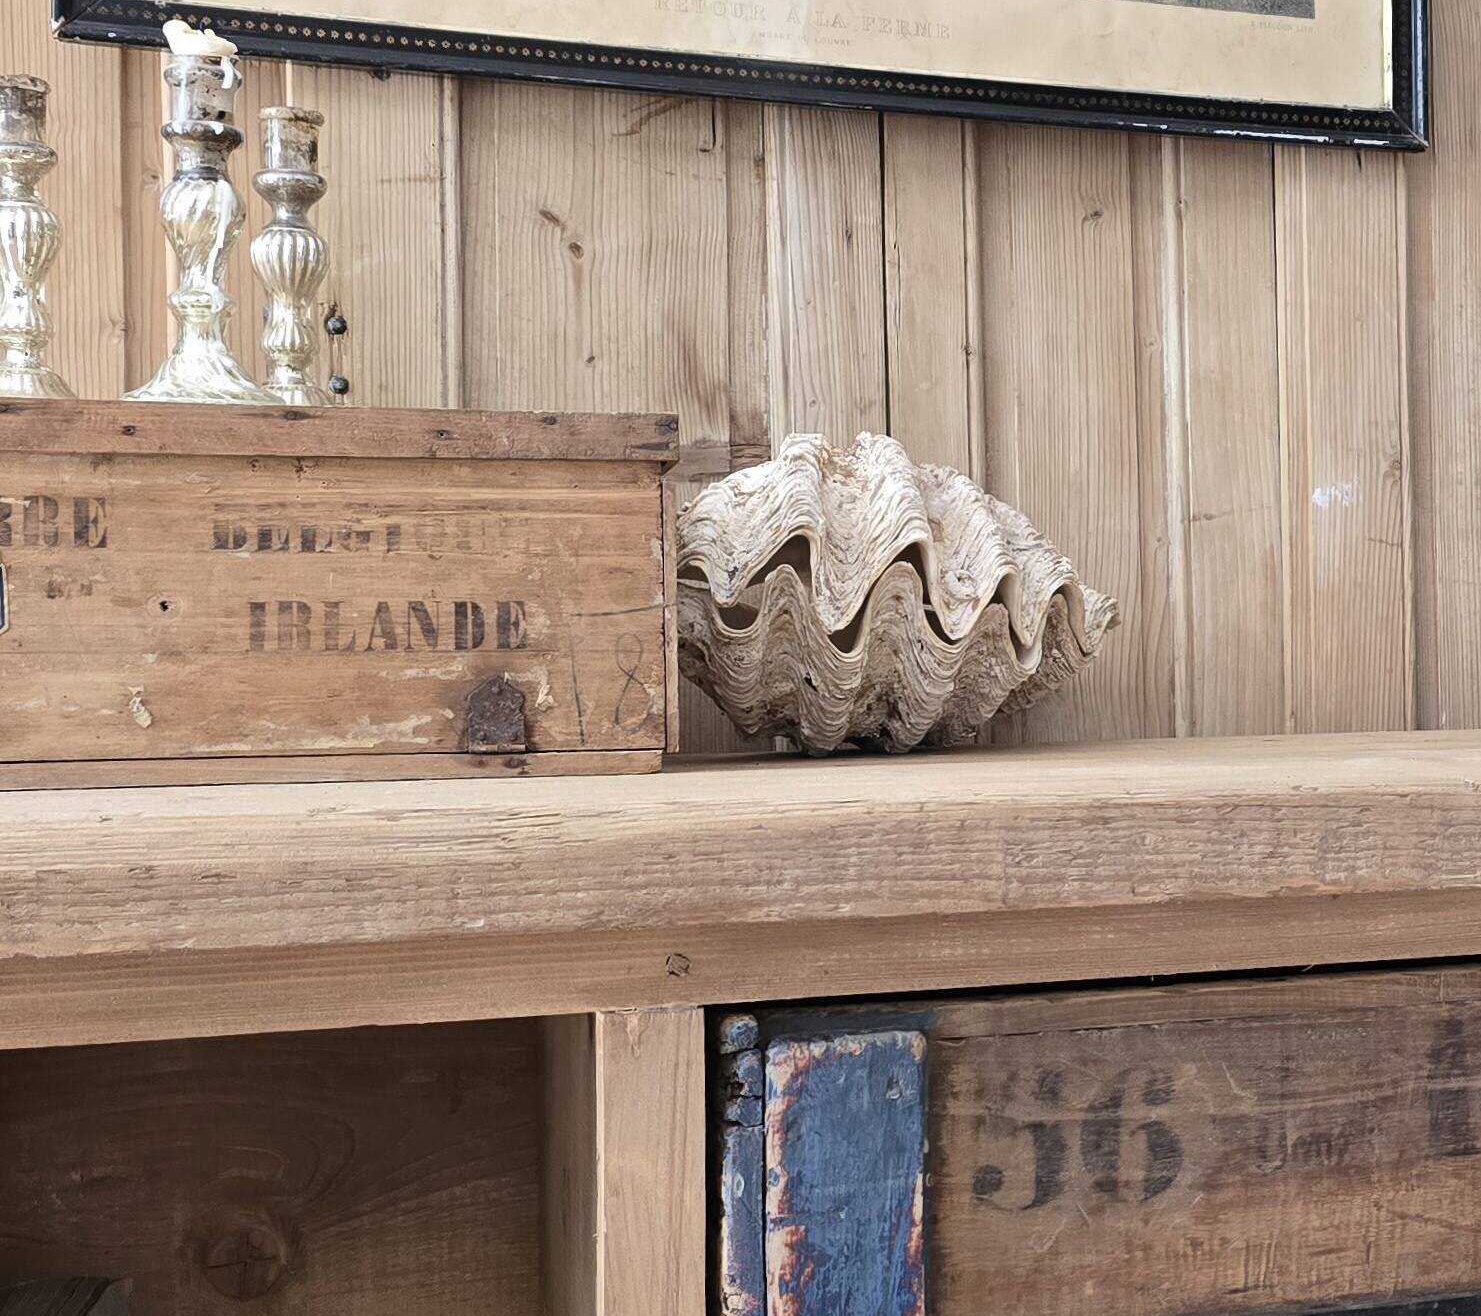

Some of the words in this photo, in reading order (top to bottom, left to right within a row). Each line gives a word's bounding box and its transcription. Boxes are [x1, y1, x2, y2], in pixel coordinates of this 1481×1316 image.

[815, 10, 849, 29] LA
[860, 15, 950, 39] FERME
[247, 600, 528, 651] IRLANDE
